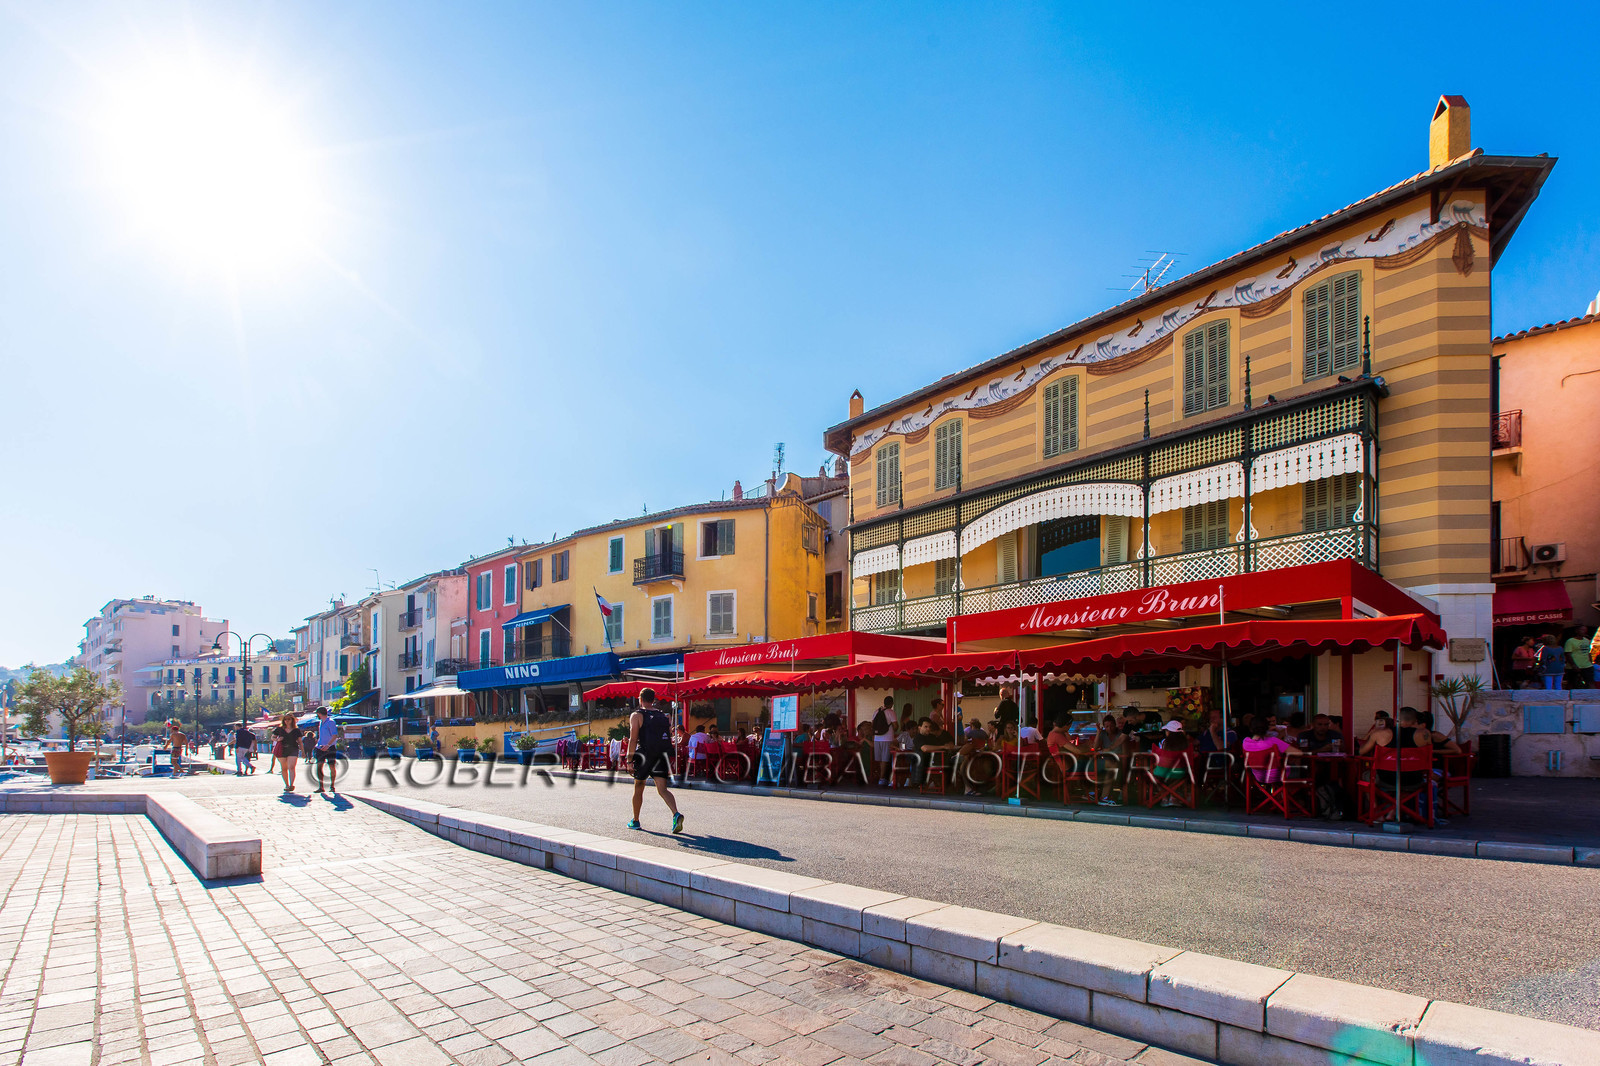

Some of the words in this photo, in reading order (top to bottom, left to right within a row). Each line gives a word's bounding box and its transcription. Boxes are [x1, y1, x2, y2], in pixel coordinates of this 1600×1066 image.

[1020, 606, 1134, 630] Monsieur
[1138, 588, 1227, 615] Brun
[515, 620, 535, 628] NINO
[715, 651, 764, 666] Monsieur
[765, 643, 801, 660] Brun
[504, 664, 540, 679] NINO
